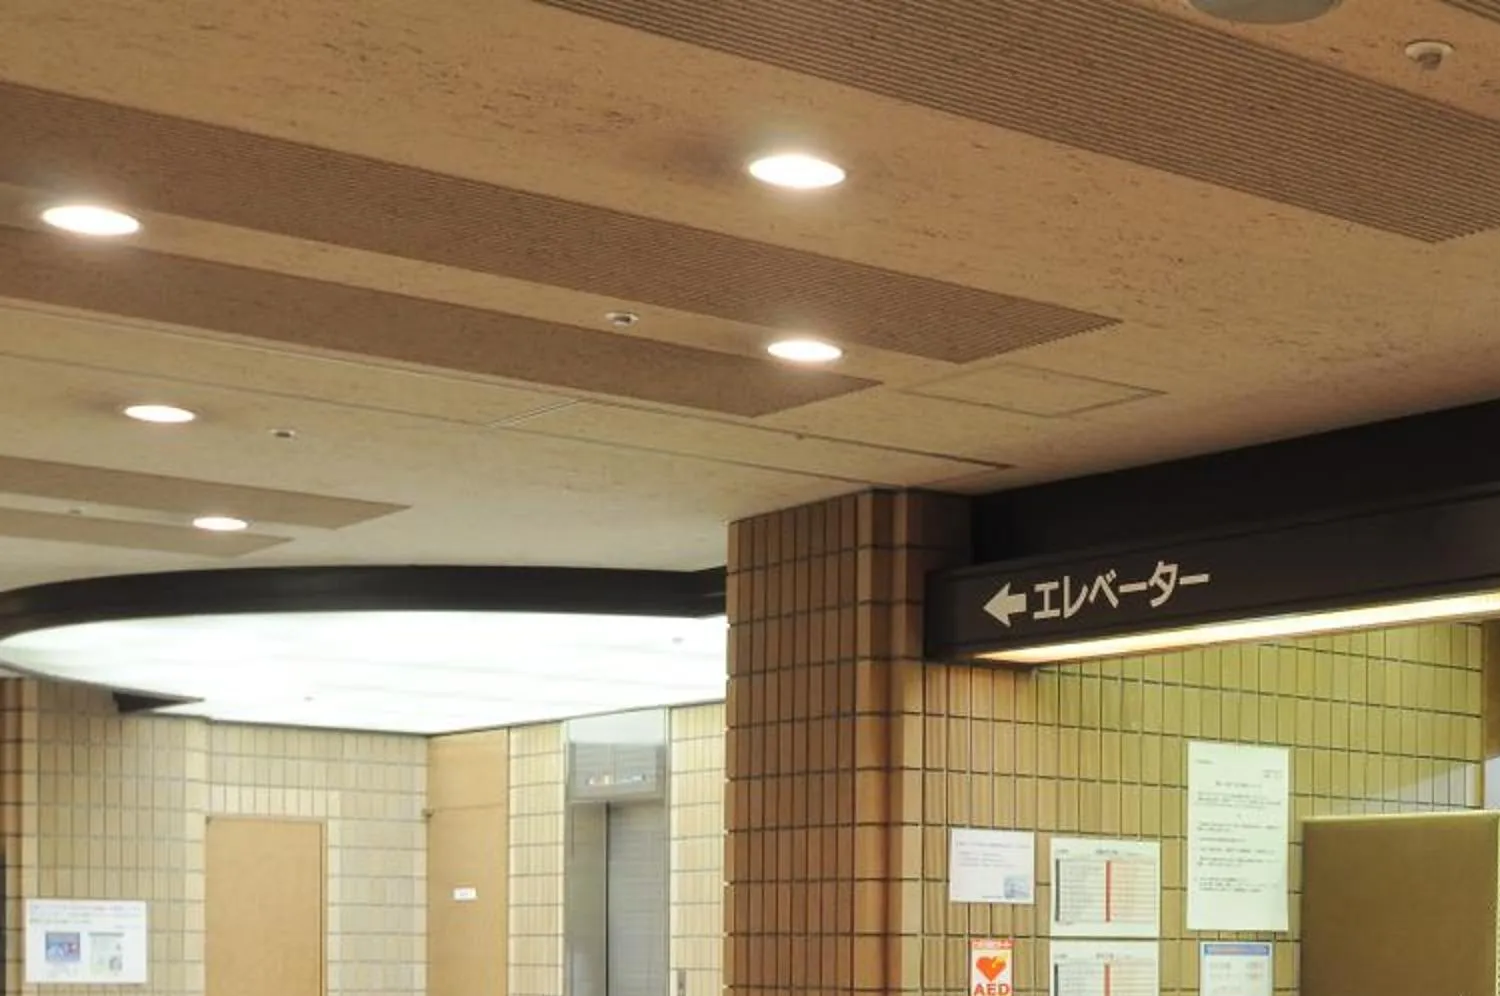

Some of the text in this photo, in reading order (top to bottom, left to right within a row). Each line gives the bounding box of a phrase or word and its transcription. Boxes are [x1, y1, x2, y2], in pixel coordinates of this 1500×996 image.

[1032, 560, 1211, 620] エレベーター
[974, 982, 1010, 996] AED
